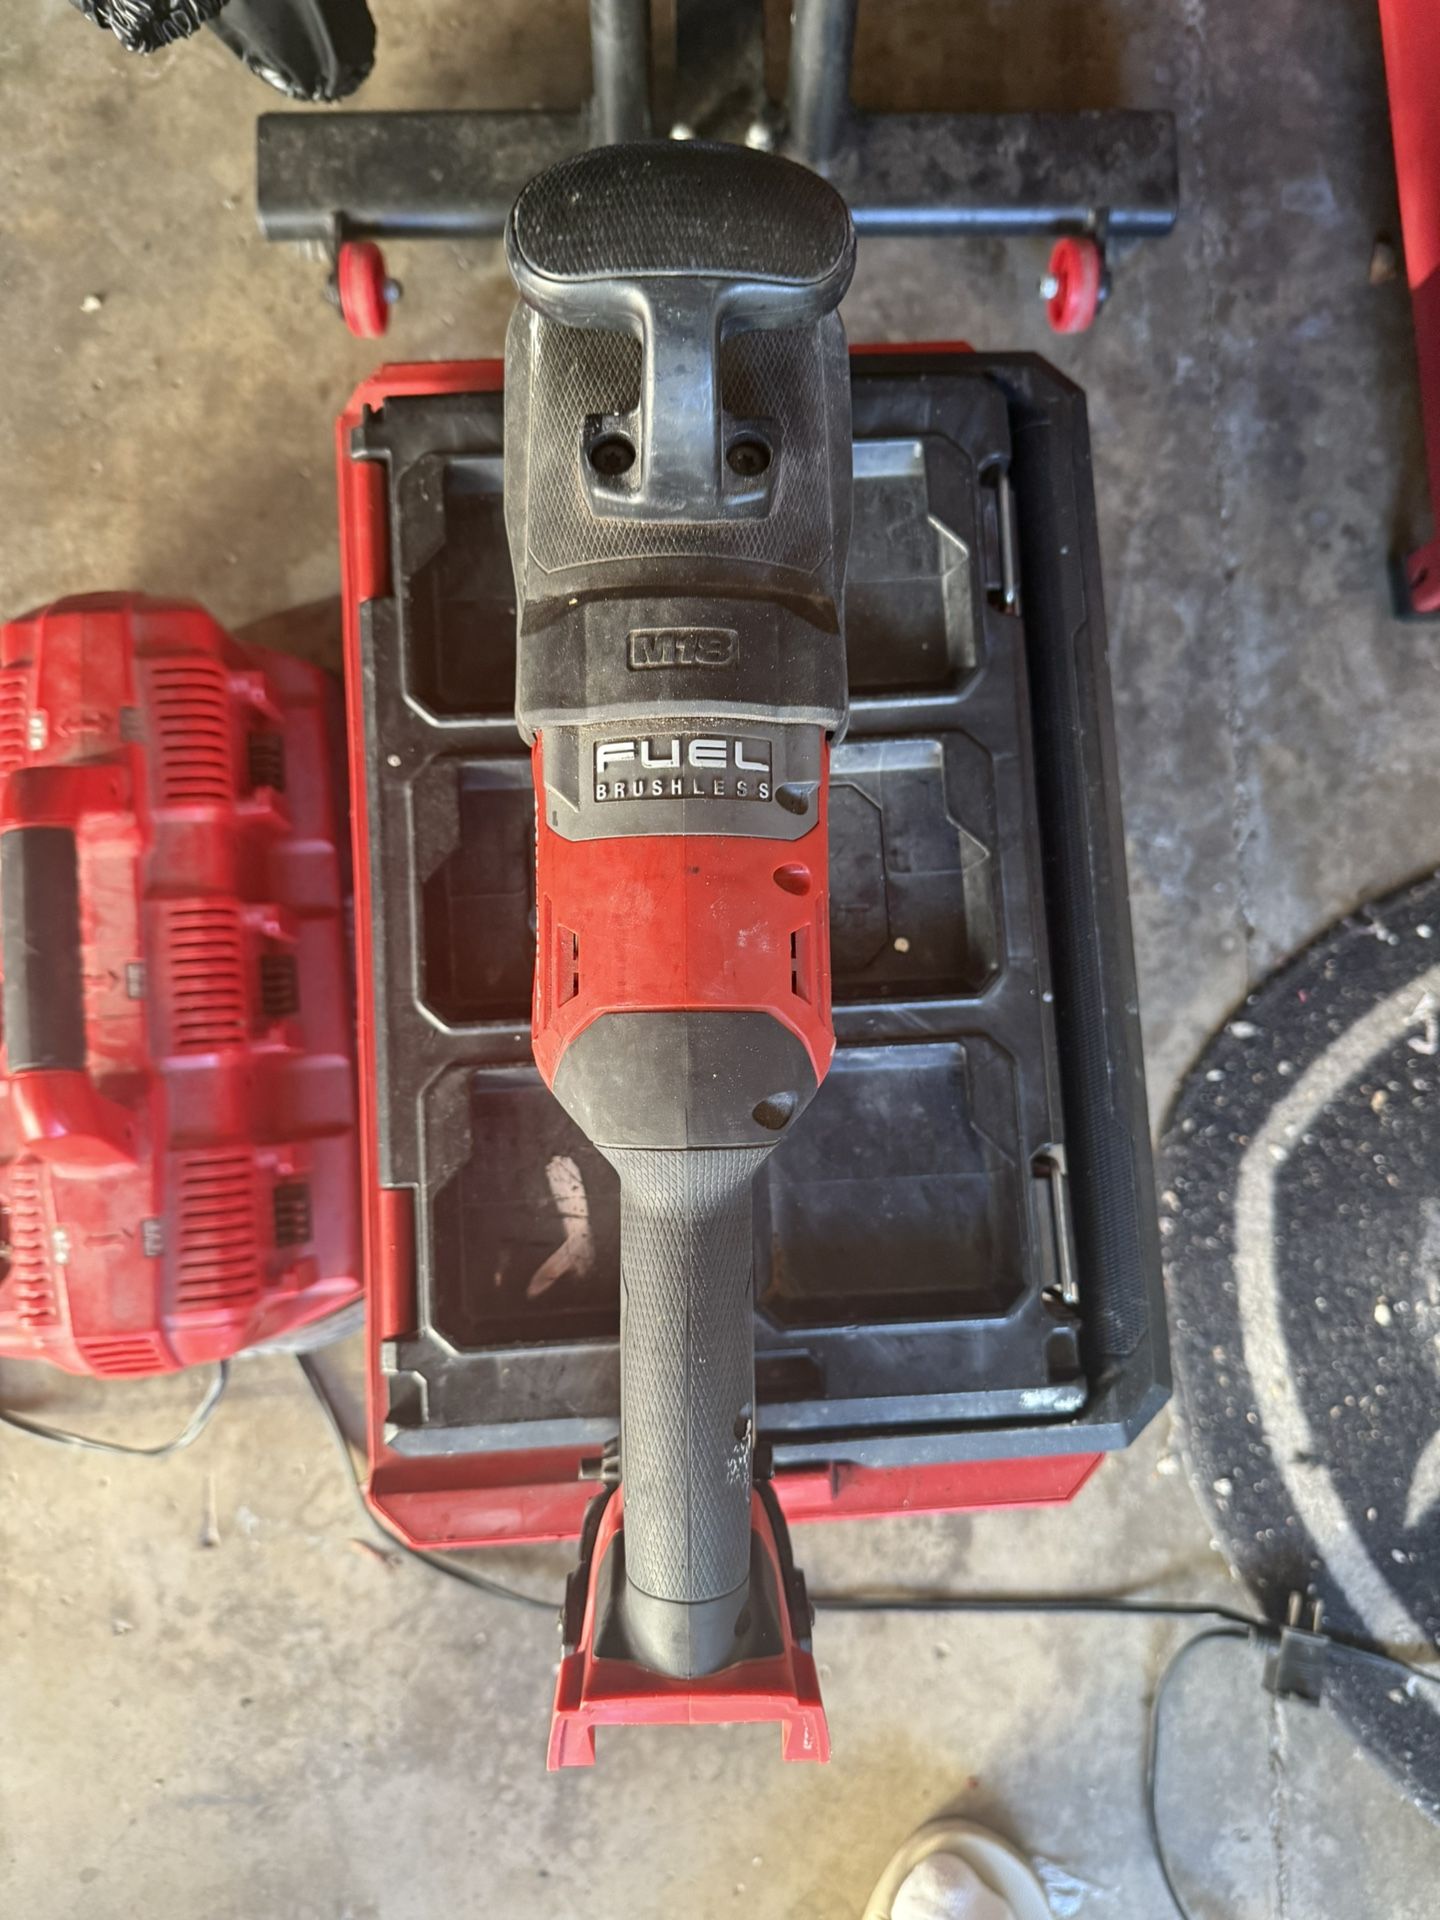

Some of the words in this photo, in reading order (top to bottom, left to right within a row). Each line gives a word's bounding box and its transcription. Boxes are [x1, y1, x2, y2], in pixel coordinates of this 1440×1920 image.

[632, 632, 733, 665] M18
[596, 739, 769, 773] FUEL
[596, 779, 769, 800] BRUSHLESS
